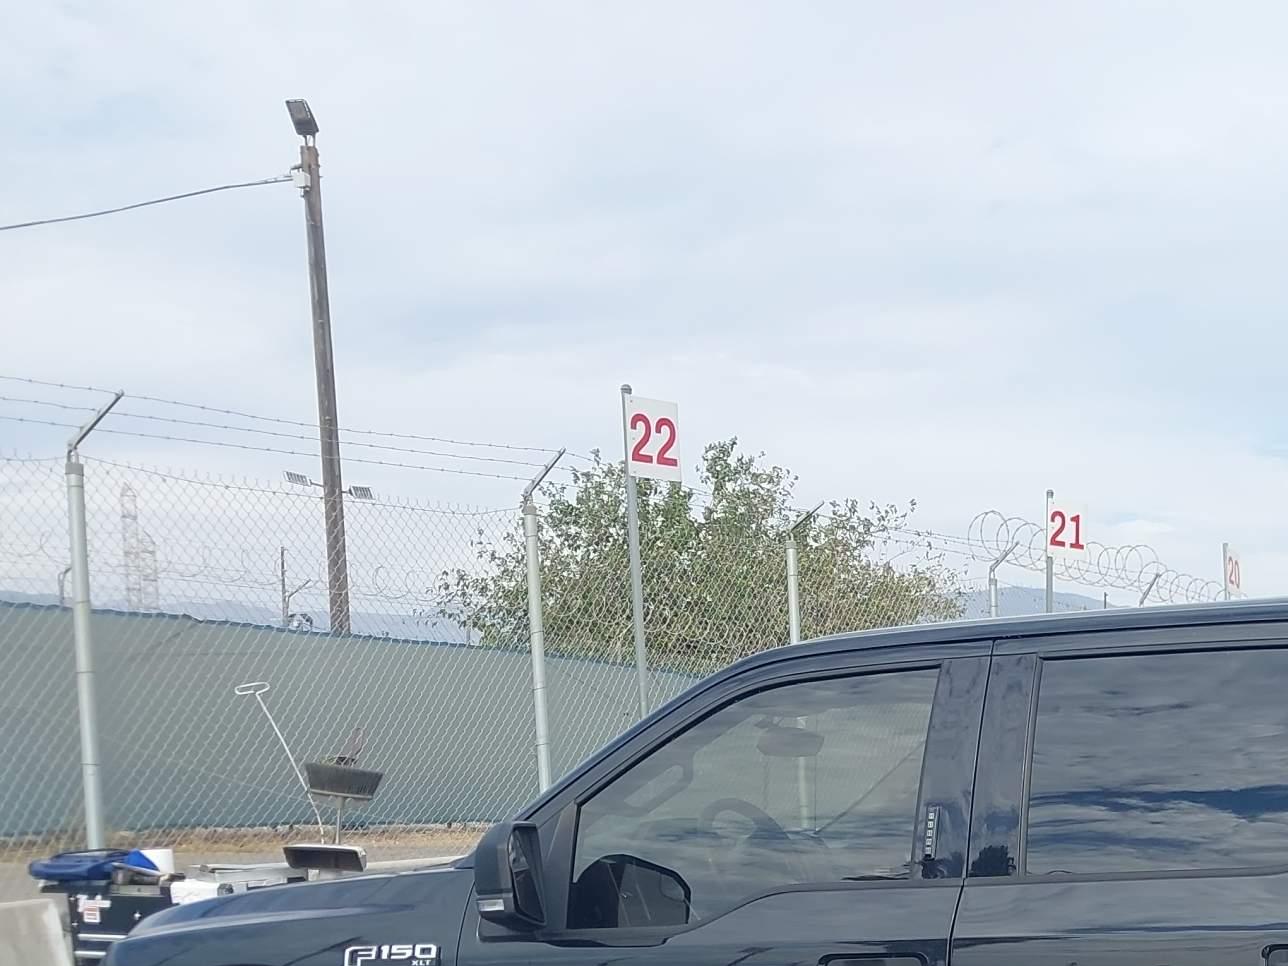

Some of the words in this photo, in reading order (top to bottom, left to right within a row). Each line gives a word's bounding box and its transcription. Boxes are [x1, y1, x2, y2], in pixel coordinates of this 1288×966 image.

[630, 413, 678, 467] 22
[1050, 510, 1085, 550] 21
[1228, 556, 1240, 589] 20
